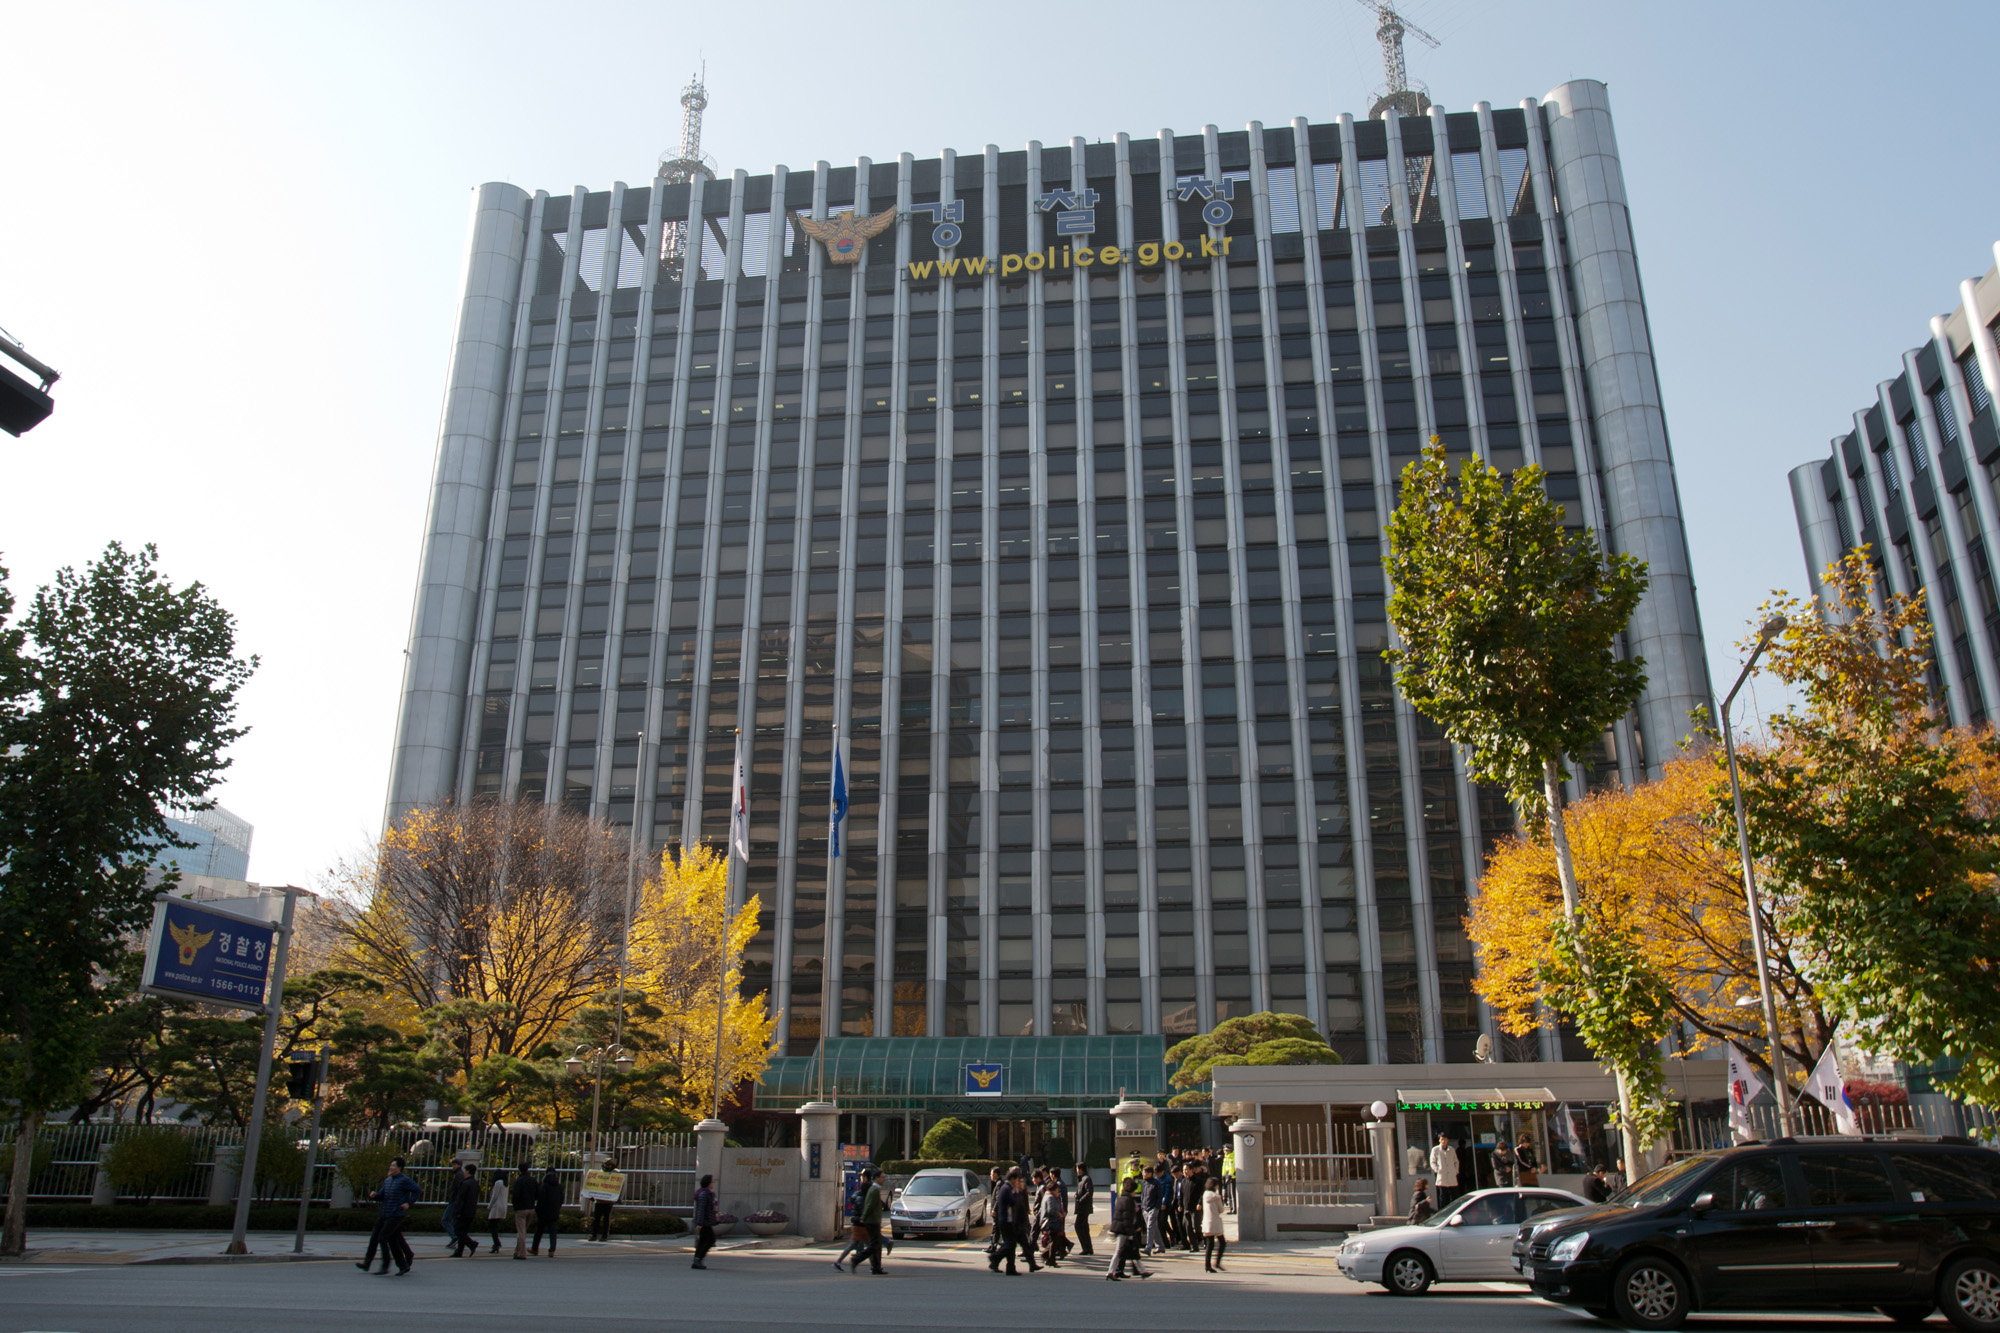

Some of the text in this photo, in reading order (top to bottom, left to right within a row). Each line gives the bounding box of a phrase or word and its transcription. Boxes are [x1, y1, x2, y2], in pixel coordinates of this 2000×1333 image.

[909, 233, 1233, 280] www.police.go.kr
[219, 931, 266, 961] 경찰청
[216, 957, 262, 971] NATIONAL POLICE AGENCY
[165, 971, 203, 983] www.police.go.kr
[211, 978, 260, 995] 1566-0112
